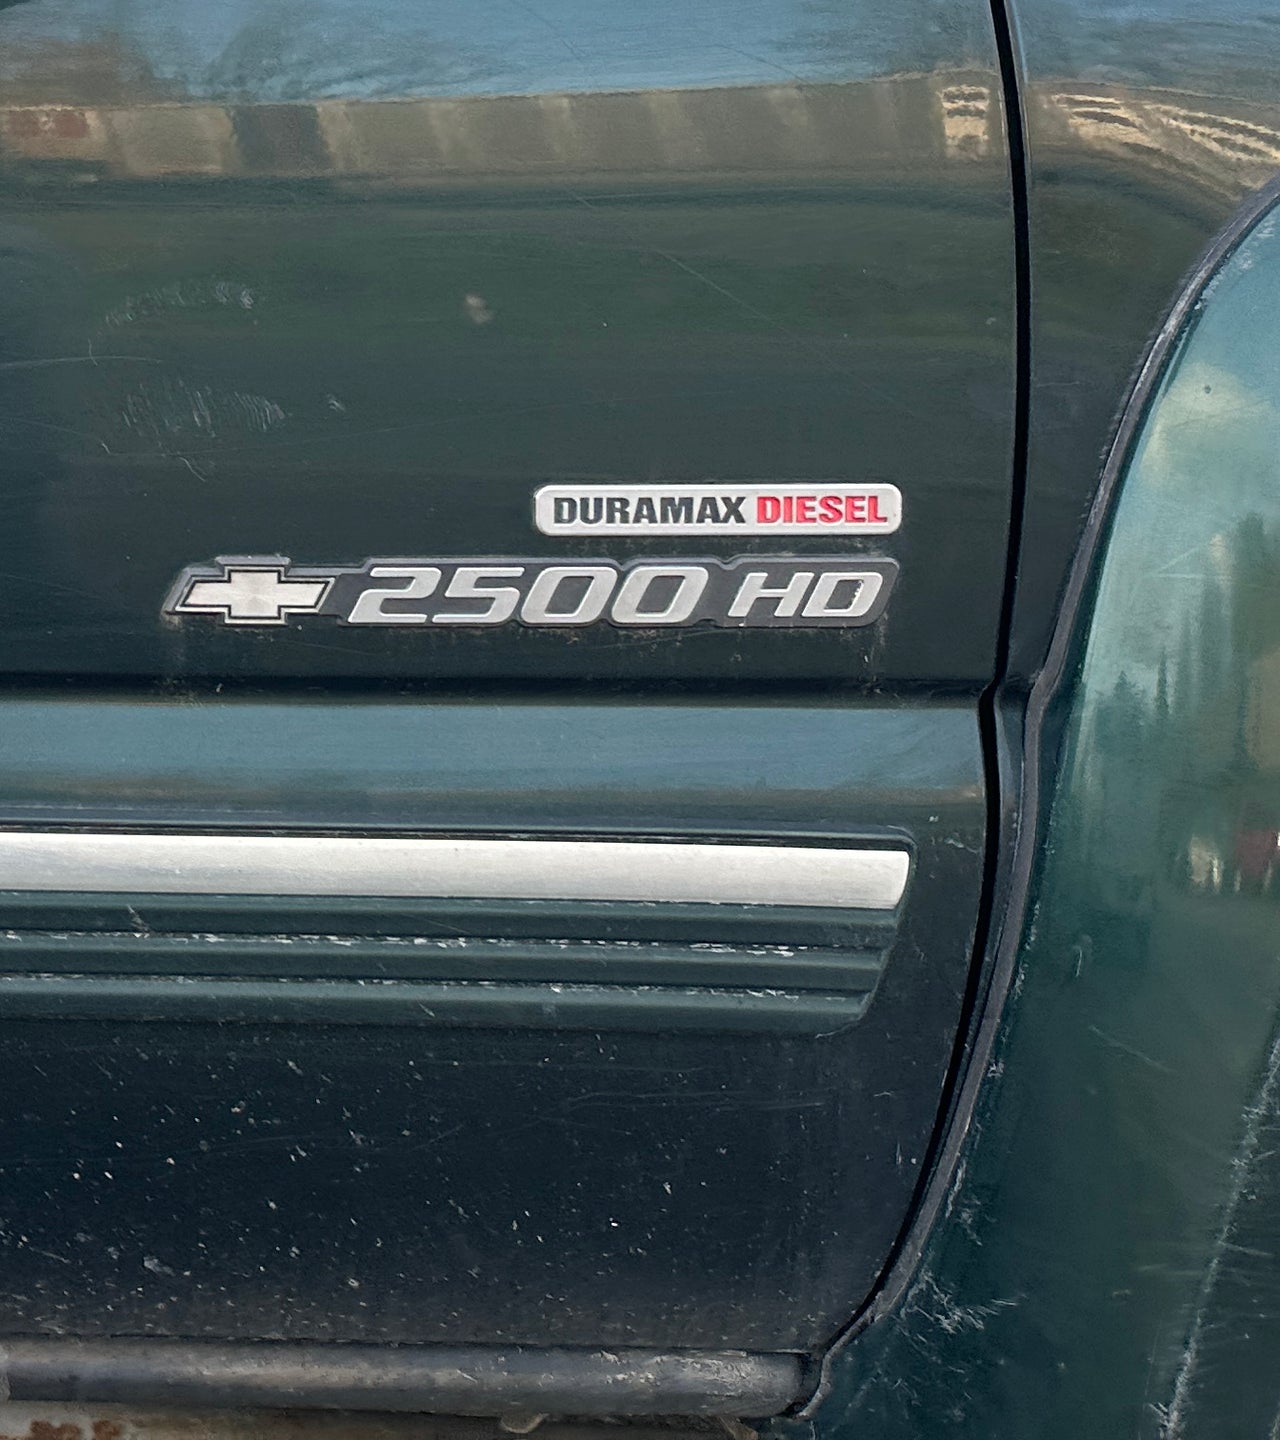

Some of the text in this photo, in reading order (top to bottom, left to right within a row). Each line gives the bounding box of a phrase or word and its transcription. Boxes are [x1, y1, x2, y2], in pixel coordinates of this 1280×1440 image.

[553, 495, 888, 524] DURAMAX DIESEL
[347, 566, 883, 624] 2500 HD
